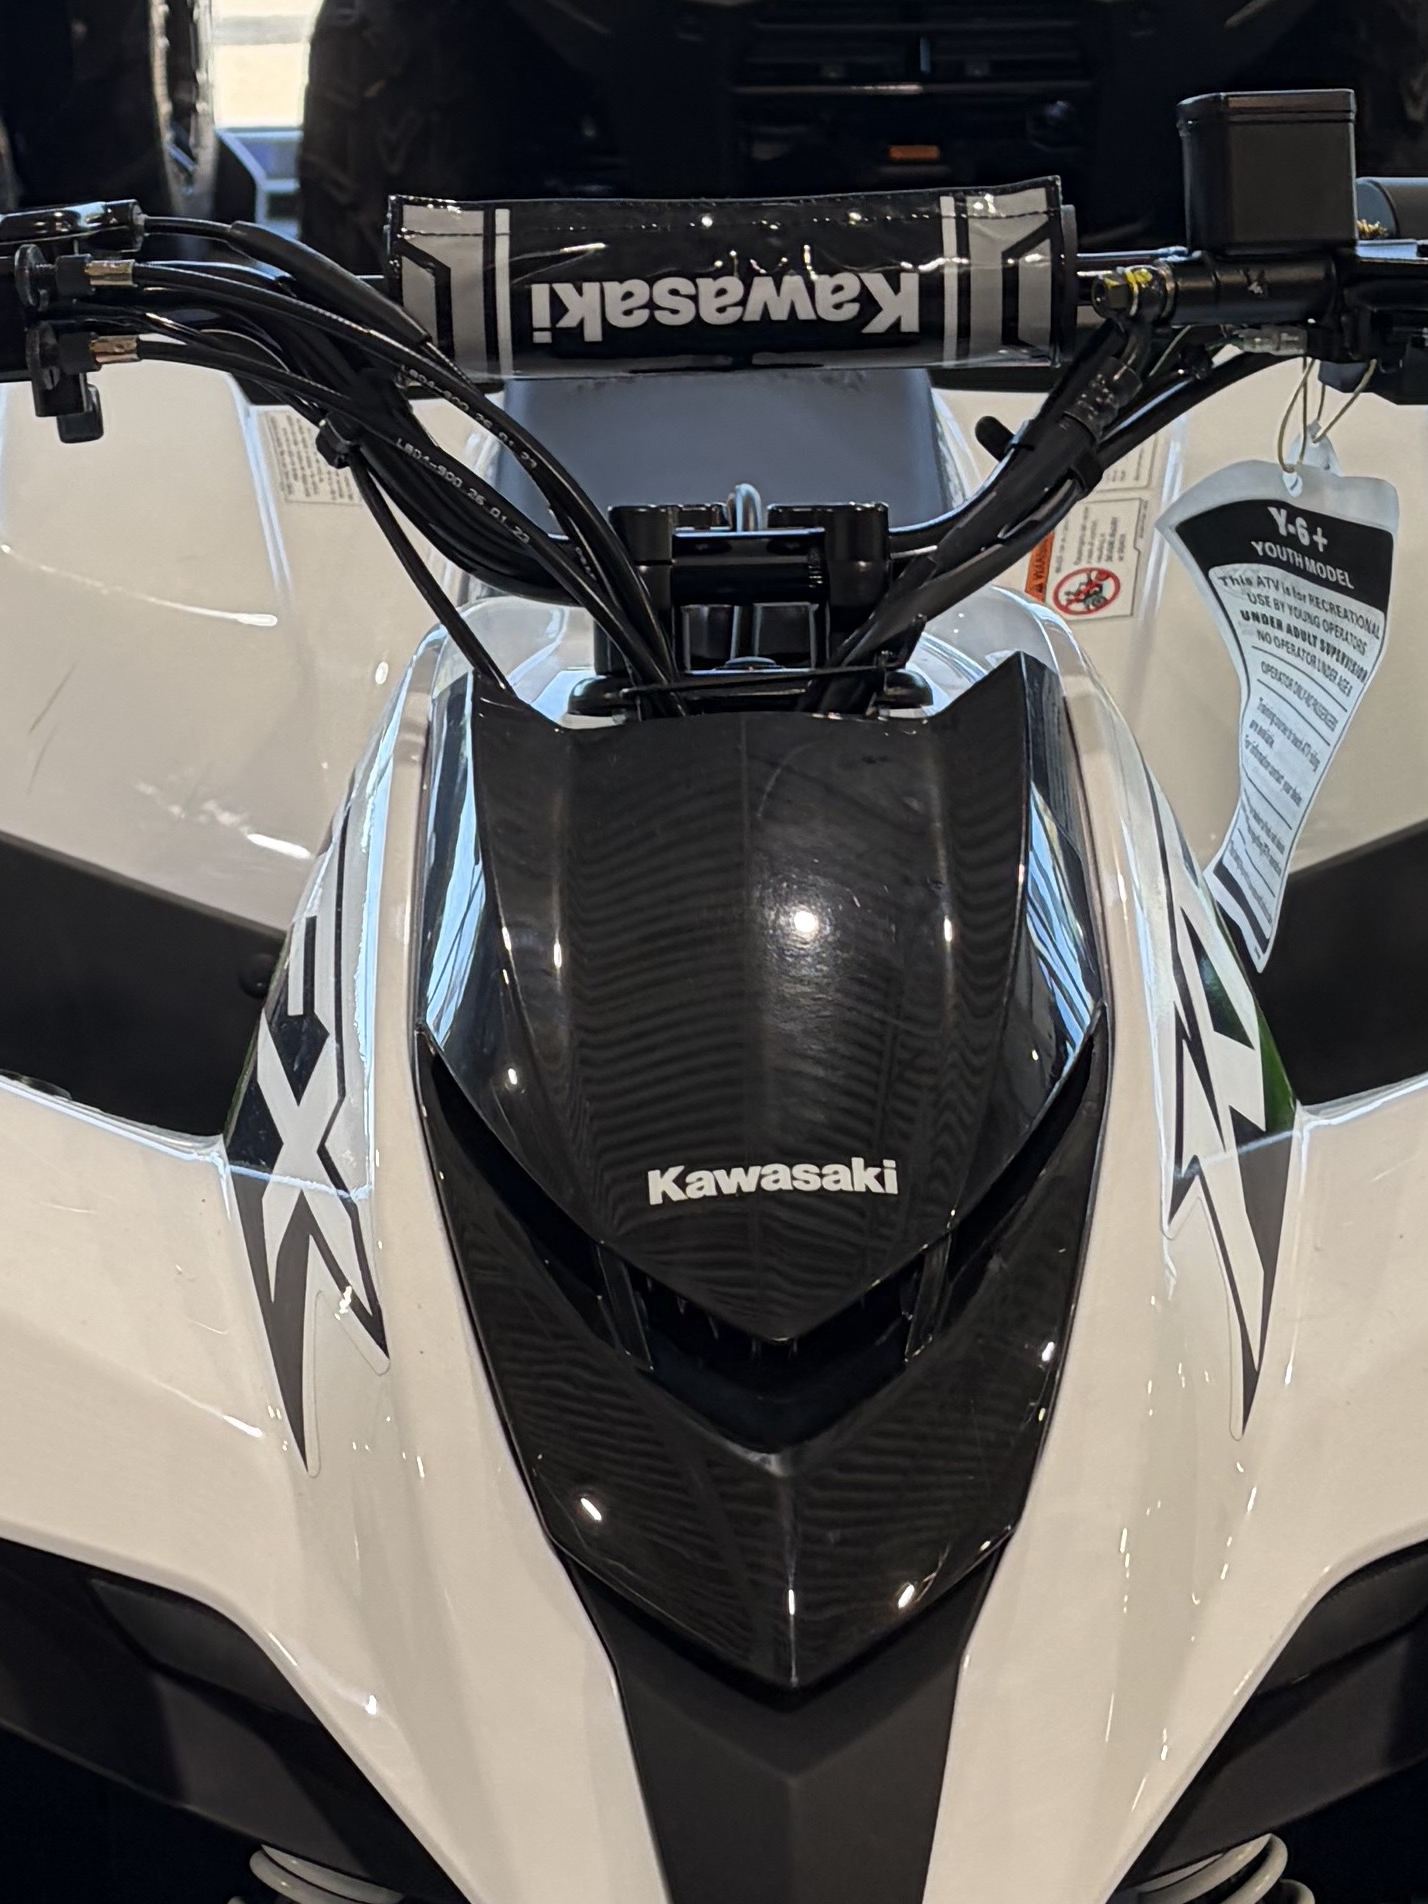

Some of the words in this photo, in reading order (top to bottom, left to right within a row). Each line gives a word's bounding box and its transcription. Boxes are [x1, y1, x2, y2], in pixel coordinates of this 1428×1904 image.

[531, 273, 921, 344] Kawasaki
[1251, 541, 1304, 572] YOUTH
[1305, 559, 1355, 590] MODEL
[1256, 574, 1281, 592] ATV
[1239, 609, 1284, 632] UNDER
[1286, 622, 1318, 645] ADULT
[1247, 593, 1271, 609] USE
[1273, 599, 1287, 615] BY
[1287, 604, 1322, 630] YOUNG
[1256, 628, 1272, 645] NO
[647, 1156, 899, 1206] Kawasaki
